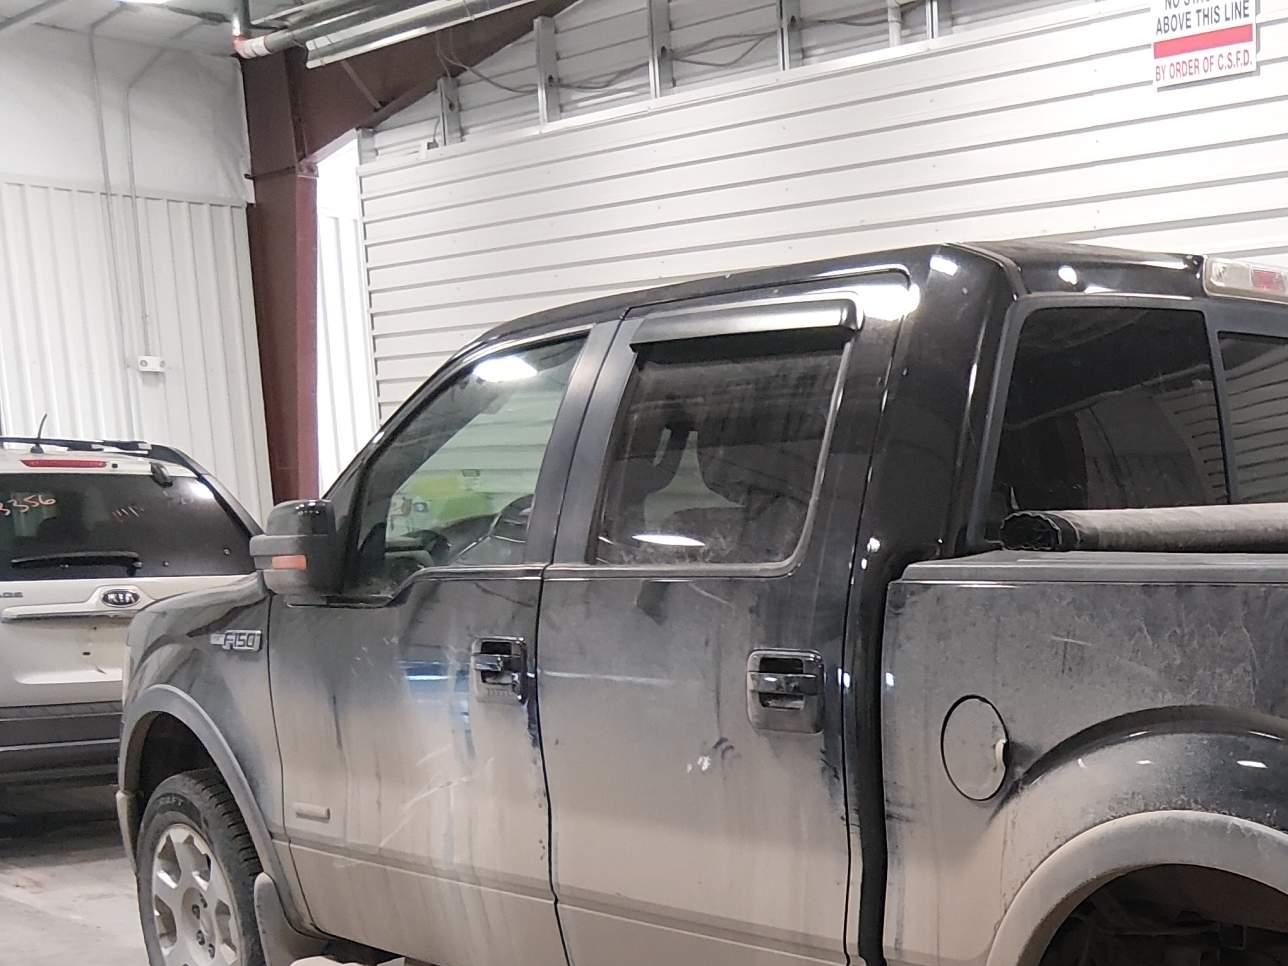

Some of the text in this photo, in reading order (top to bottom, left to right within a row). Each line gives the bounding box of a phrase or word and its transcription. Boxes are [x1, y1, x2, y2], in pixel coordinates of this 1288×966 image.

[1156, 0, 1250, 35] ABOVE THIS LINE
[1155, 49, 1253, 82] BY ORDER OF C.S.F.D.
